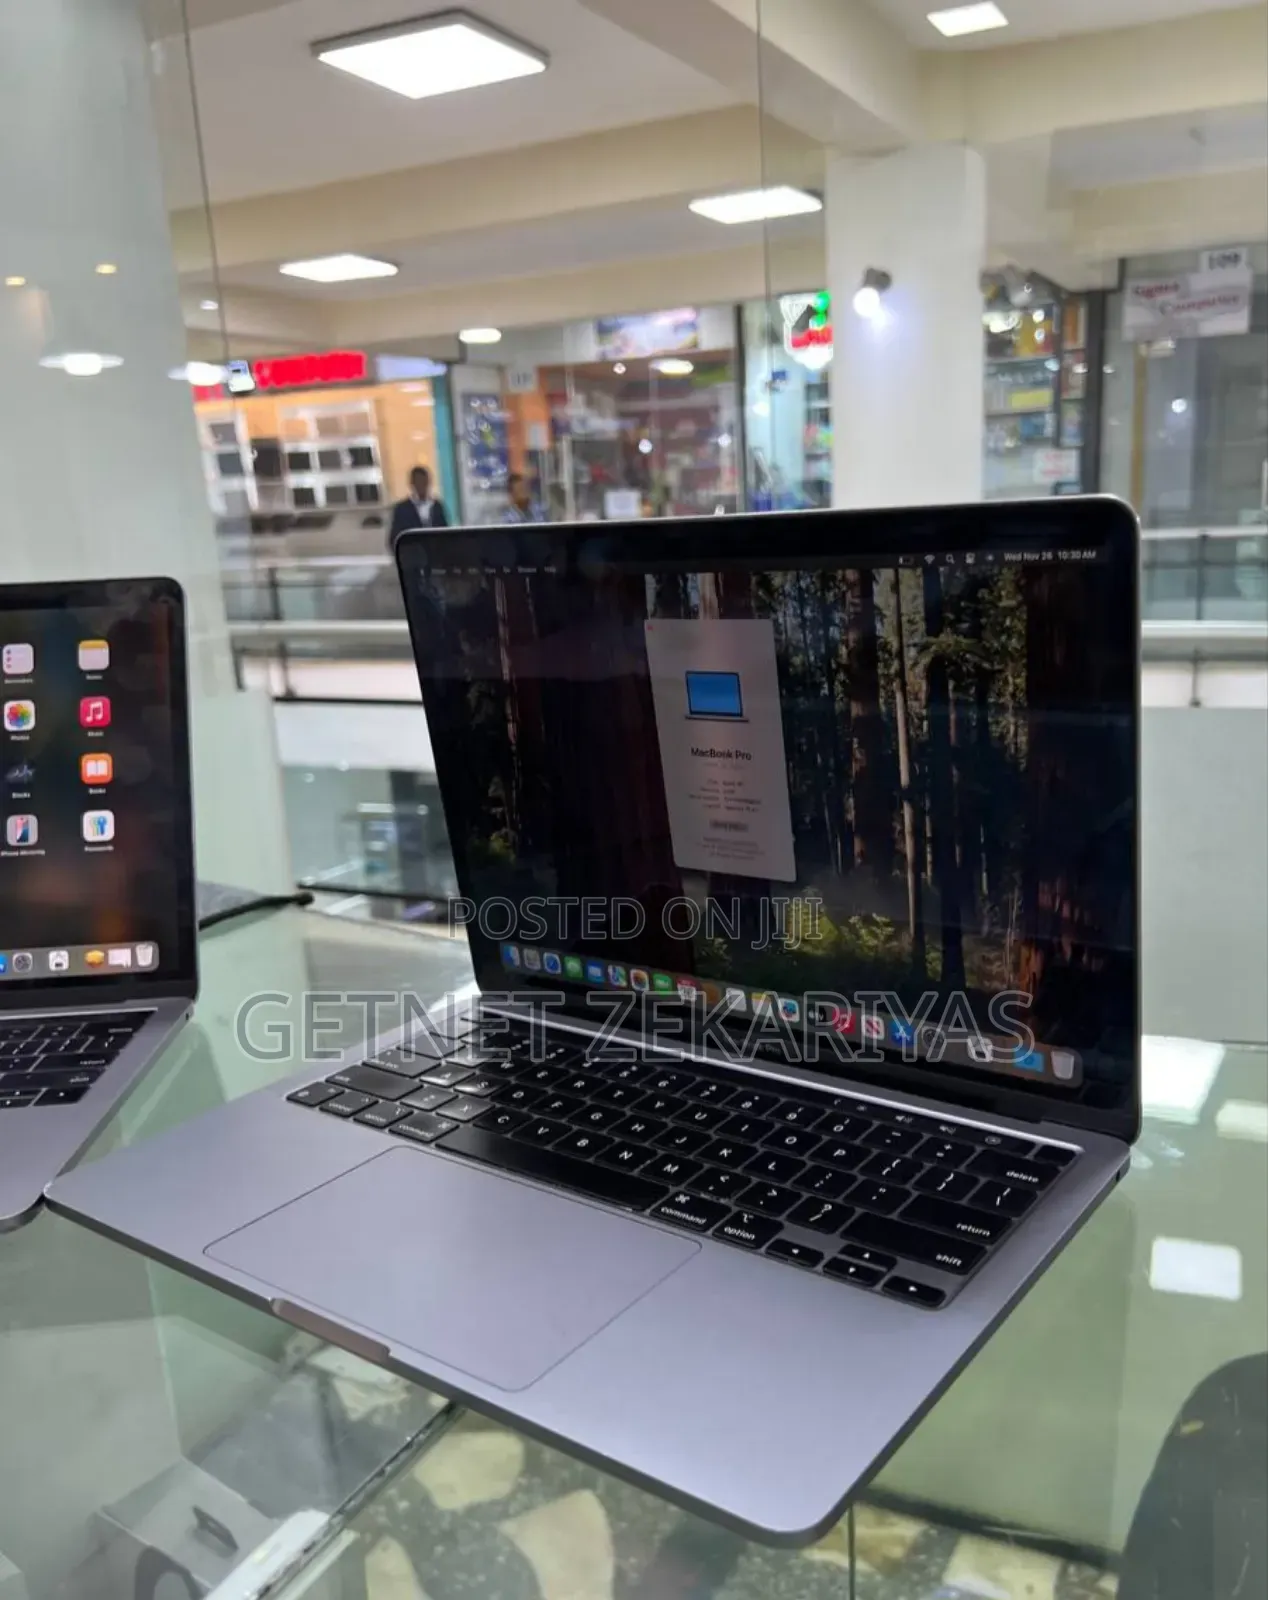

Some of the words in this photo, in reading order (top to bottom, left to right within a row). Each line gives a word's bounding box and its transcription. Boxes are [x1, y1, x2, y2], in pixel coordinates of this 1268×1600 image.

[690, 747, 733, 759] MacBook
[735, 749, 752, 761] Pro
[1006, 1170, 1039, 1183] delete
[661, 1206, 707, 1225] command
[724, 1226, 756, 1241] option
[956, 1221, 991, 1237] return
[935, 1253, 962, 1267] shift
